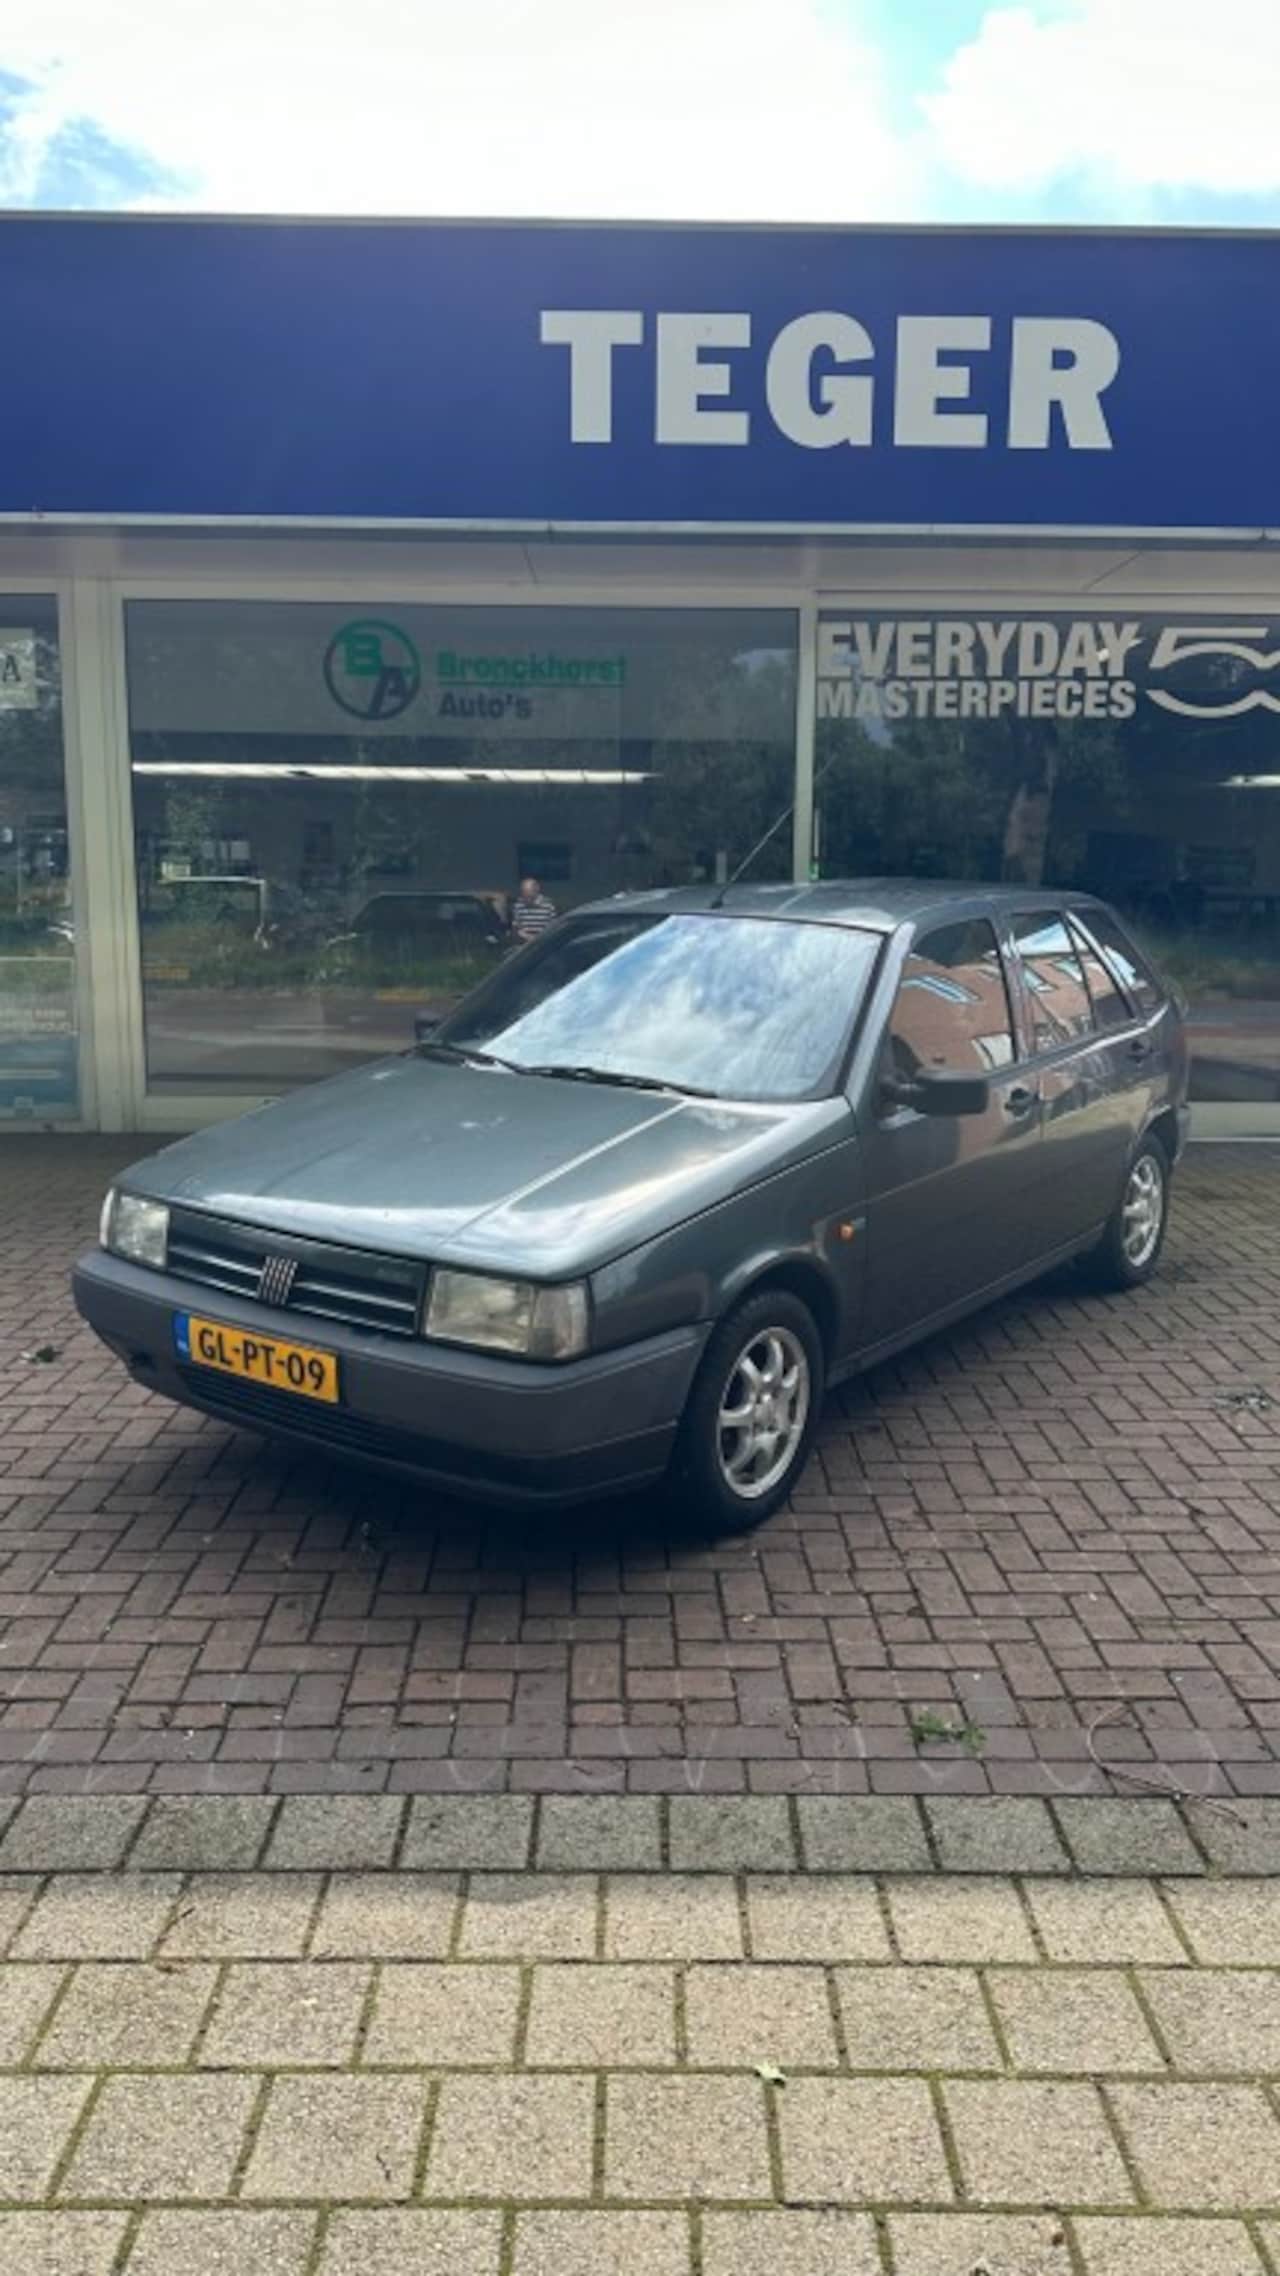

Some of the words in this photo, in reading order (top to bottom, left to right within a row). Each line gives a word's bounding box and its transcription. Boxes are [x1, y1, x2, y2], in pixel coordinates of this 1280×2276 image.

[540, 310, 1120, 450] TEGER
[436, 651, 627, 683] Bronckhorst
[816, 621, 1142, 678] EVERYDAY
[436, 692, 533, 719] Auto's
[817, 680, 1136, 718] MASTERPIECES
[199, 1328, 326, 1391] GL-PT-09
